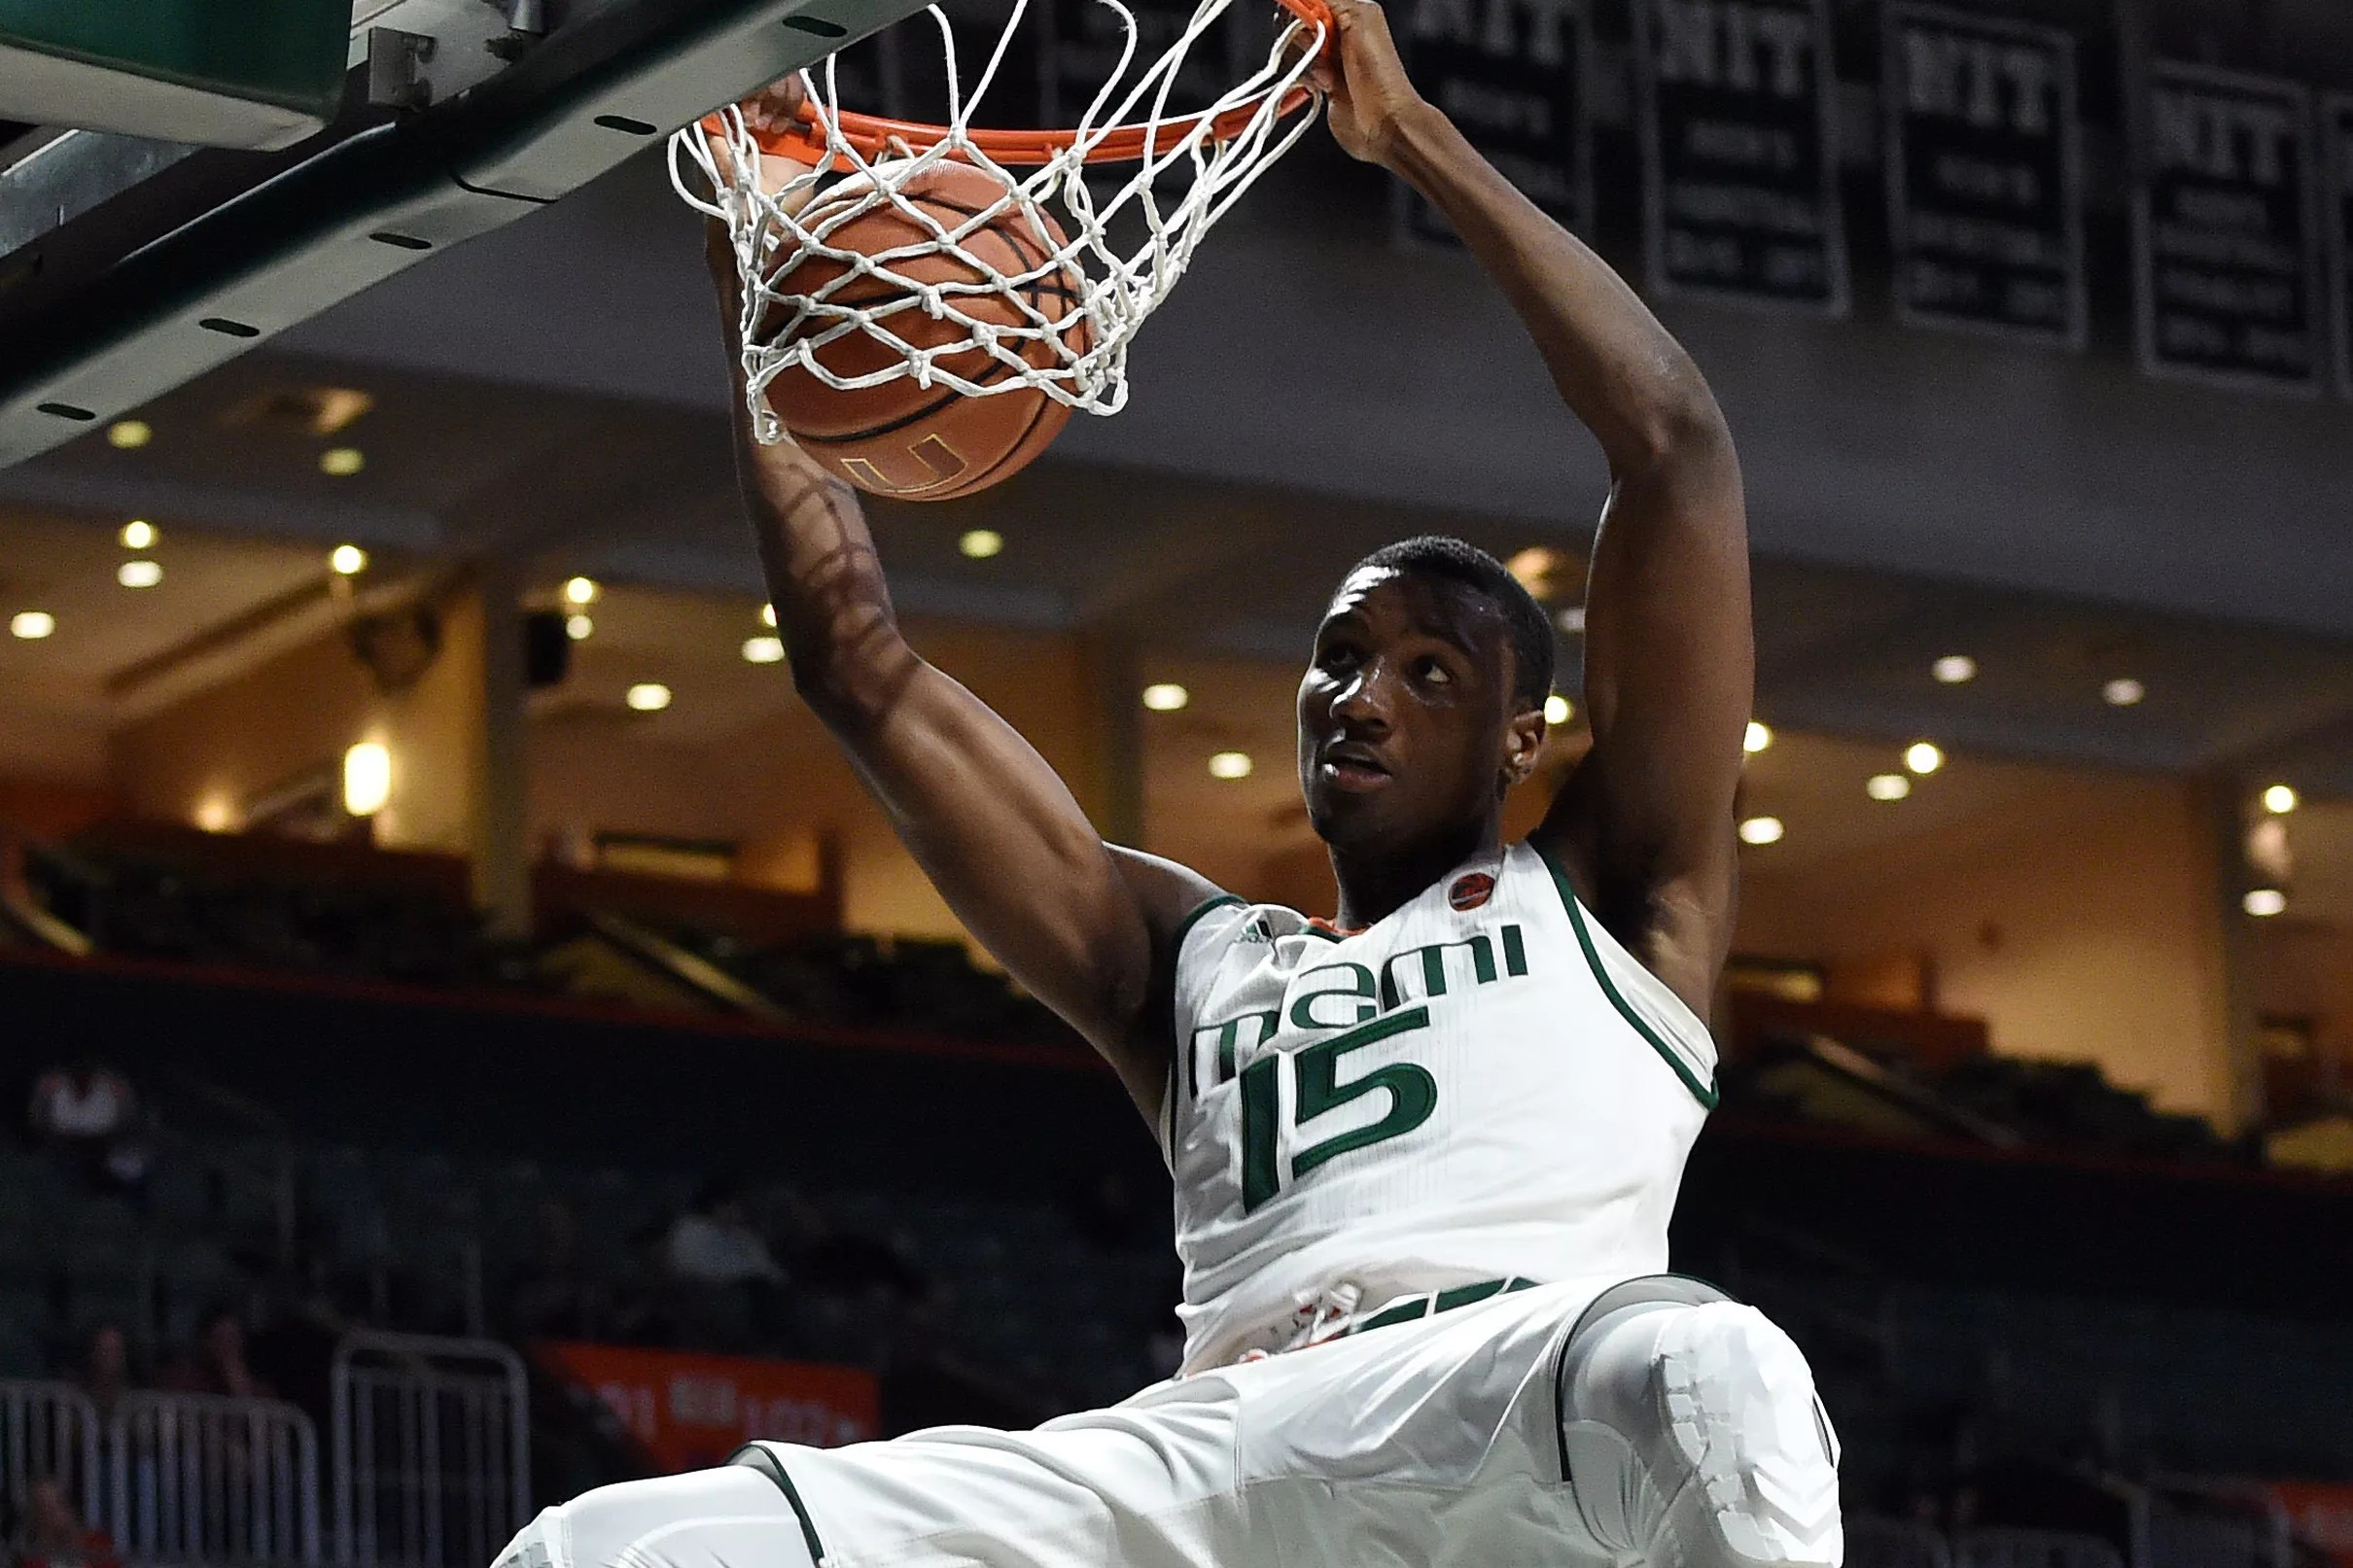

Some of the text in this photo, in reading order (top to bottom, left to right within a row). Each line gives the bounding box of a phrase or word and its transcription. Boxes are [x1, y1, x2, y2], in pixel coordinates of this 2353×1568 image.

[1656, 0, 1809, 95] NIT
[1907, 29, 2052, 134] NIT
[2151, 89, 2288, 186] NIT
[1240, 1006, 1438, 1216] 15
